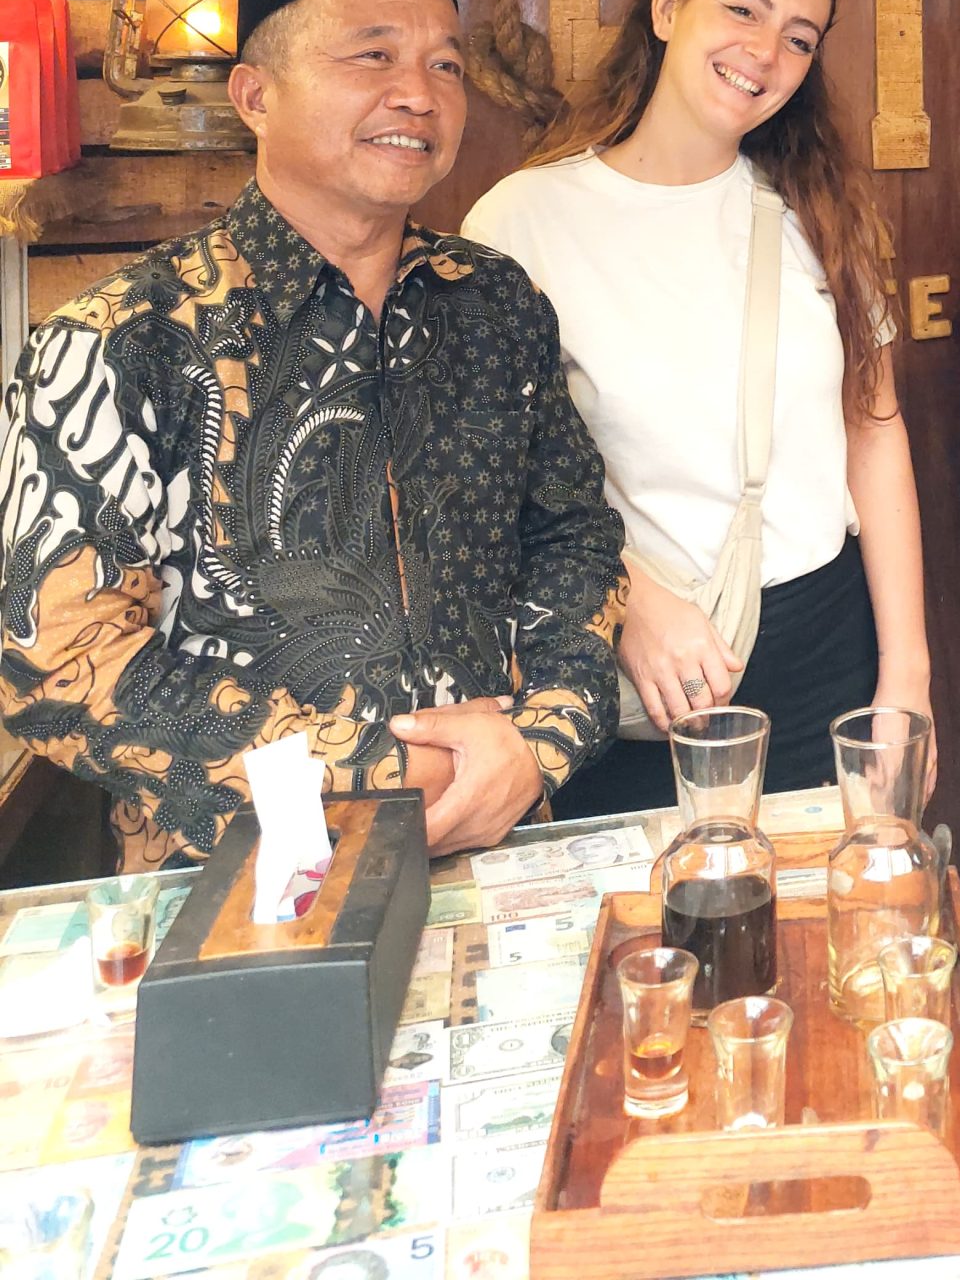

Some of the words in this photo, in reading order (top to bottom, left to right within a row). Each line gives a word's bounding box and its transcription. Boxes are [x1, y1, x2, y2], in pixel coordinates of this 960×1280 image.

[555, 916, 574, 932] 5
[143, 1226, 210, 1261] 20
[410, 1235, 435, 1260] 5
